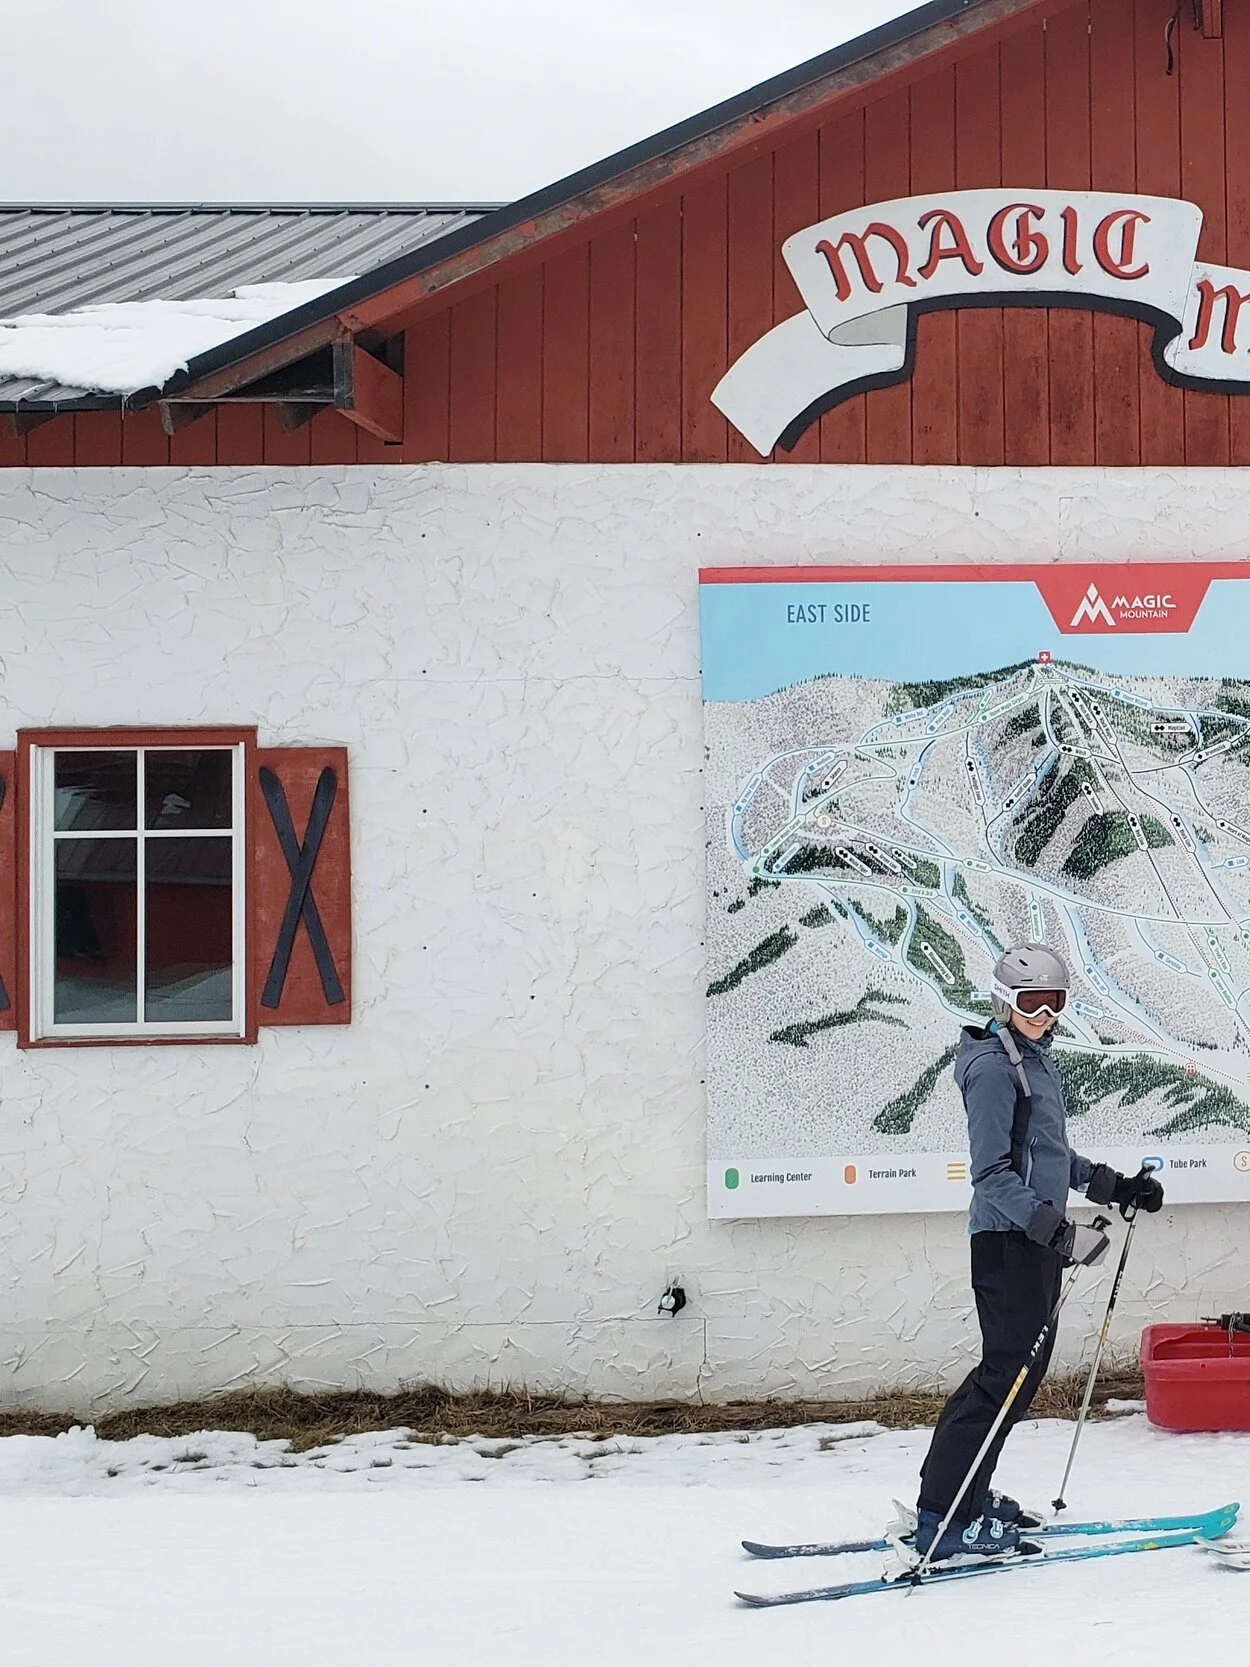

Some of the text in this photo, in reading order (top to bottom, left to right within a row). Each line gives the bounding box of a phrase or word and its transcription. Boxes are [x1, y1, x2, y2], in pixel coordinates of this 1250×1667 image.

[815, 202, 1152, 302] MAGIC
[1111, 594, 1177, 609] MAGIC
[787, 604, 870, 623] EAST SIDE
[1120, 610, 1168, 619] MOUNTAIN
[999, 701, 1013, 711] Magic
[1011, 695, 1024, 705] Carpet
[1099, 716, 1113, 739] Black Magic
[970, 774, 979, 790] Twilight
[779, 828, 791, 839] Magic
[788, 818, 801, 831] Carpet
[1226, 825, 1238, 835] Heart
[1179, 828, 1192, 847] Black Line
[878, 852, 891, 863] Green
[857, 864, 869, 875] Tiger
[927, 951, 952, 980] Disappearing Act
[1170, 1158, 1207, 1169] Tube Park
[1241, 1156, 1247, 1167] S
[750, 1172, 812, 1184] Learning Center
[868, 1168, 917, 1179] Terrain Park
